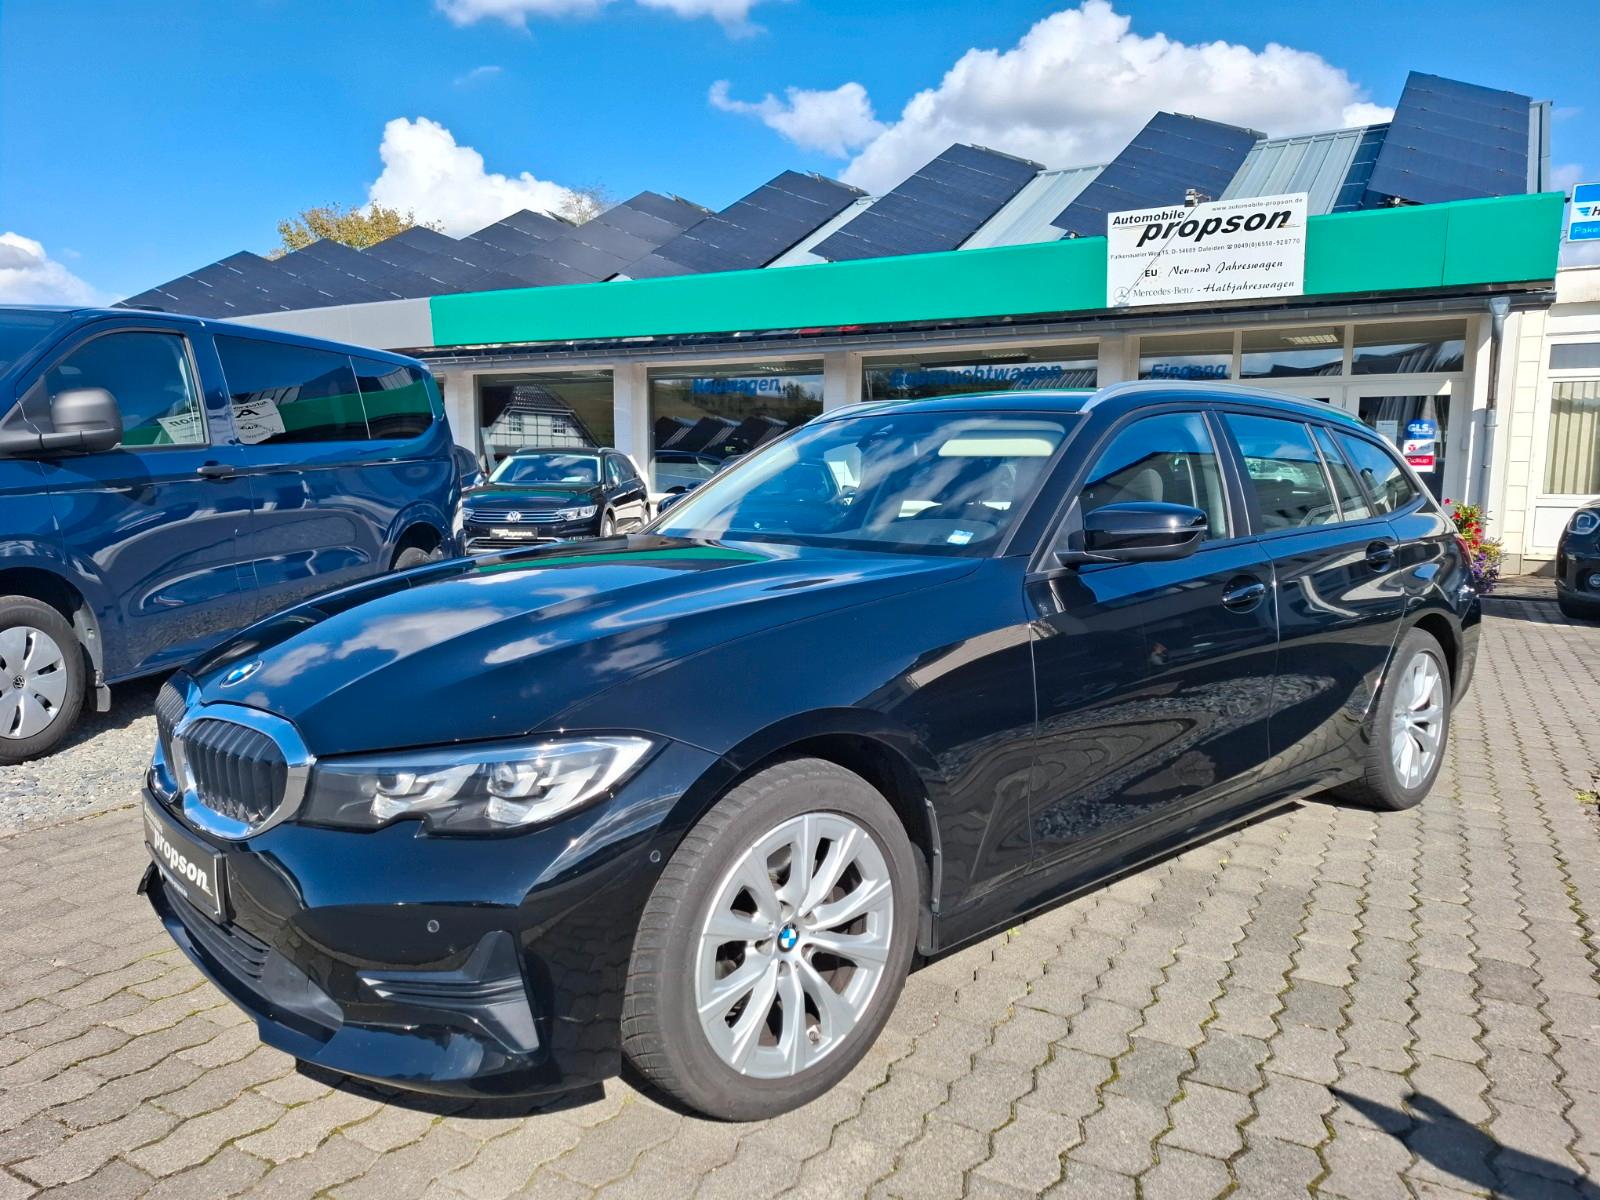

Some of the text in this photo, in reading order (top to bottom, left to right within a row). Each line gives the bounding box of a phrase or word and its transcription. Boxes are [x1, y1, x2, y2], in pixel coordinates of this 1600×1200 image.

[1112, 209, 1185, 226] Automobile
[1136, 210, 1292, 247] propson
[1144, 269, 1158, 278] EU
[1215, 261, 1283, 274] Jahreswagen
[1151, 363, 1227, 379] Eingang
[1407, 423, 1429, 432] GLS
[154, 829, 209, 892] propson
